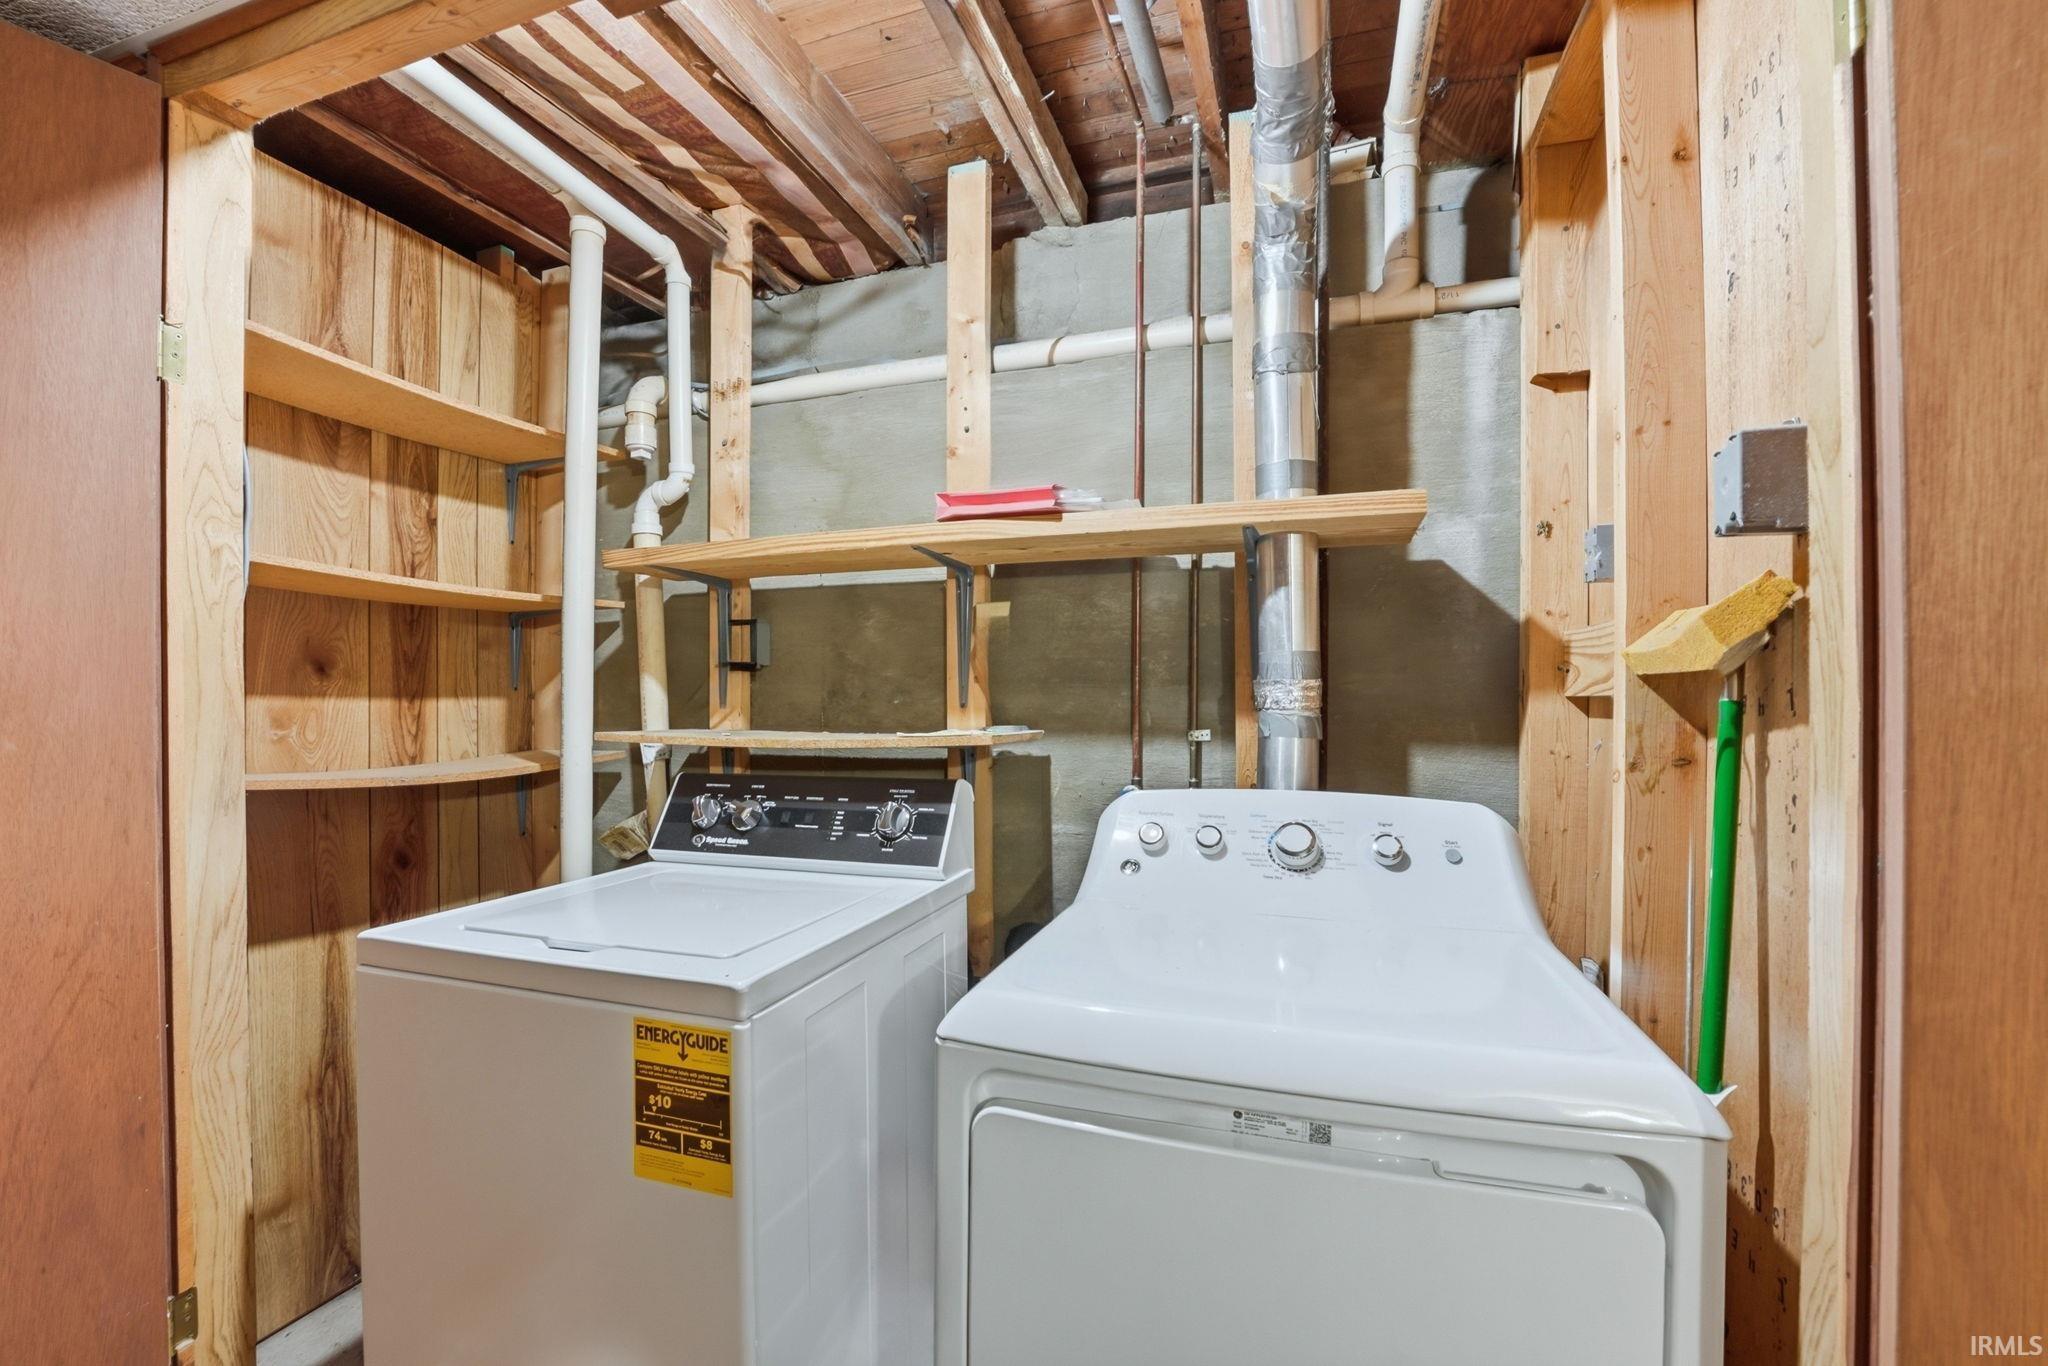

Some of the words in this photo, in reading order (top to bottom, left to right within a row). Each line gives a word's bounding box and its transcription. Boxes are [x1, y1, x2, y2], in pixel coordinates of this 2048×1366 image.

[636, 1024, 729, 1054] ENERGYGUIDE
[648, 1094, 671, 1109] $10
[648, 1129, 661, 1141] 74
[700, 1139, 713, 1150] $8
